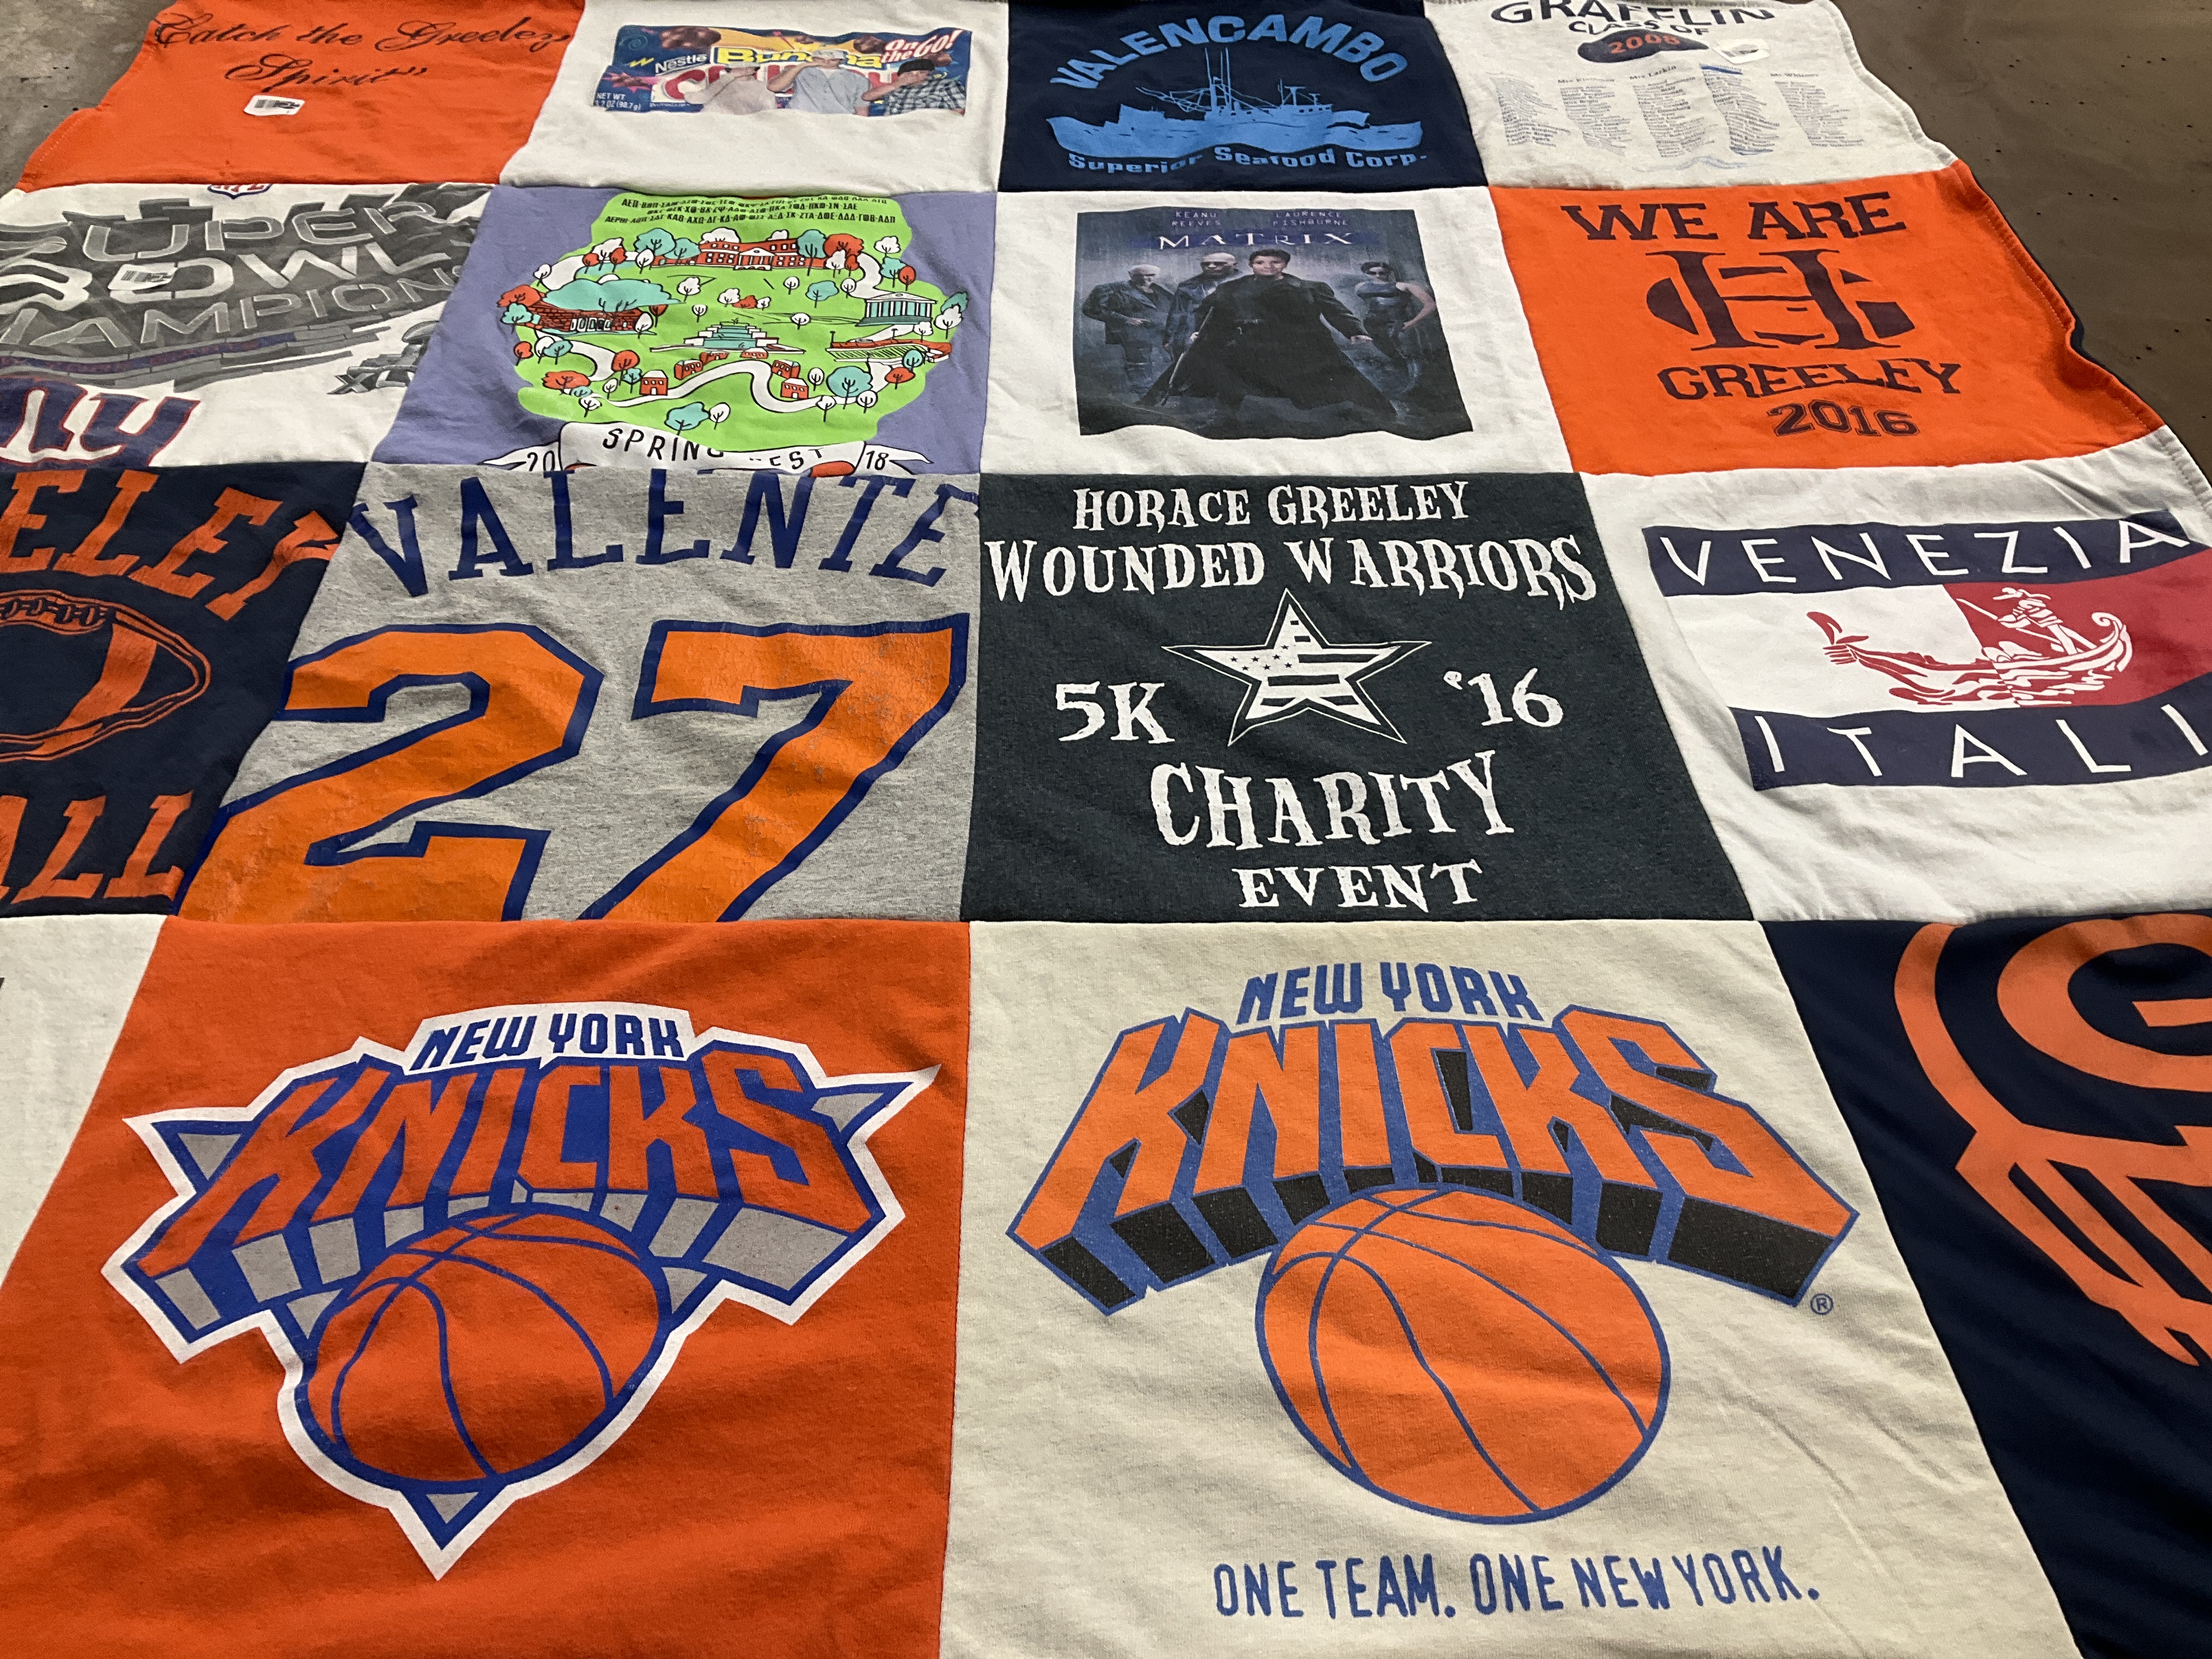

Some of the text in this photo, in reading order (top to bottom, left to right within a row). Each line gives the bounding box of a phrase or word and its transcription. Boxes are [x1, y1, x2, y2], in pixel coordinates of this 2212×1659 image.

[153, 13, 571, 53] Catch the Greeley
[885, 38, 921, 50] On
[915, 30, 966, 59] GO!
[1049, 14, 1408, 89] VALENCAMBO
[1568, 20, 1709, 36] CLASS OF
[1607, 33, 1681, 54] 2008
[881, 50, 913, 63] the
[1068, 152, 1203, 174] Superior
[1214, 145, 1336, 166] Seafood
[1158, 232, 1354, 250] MATRIX
[1175, 210, 1343, 219] KEANU LAURENCE
[1561, 191, 1908, 241] WE ARE
[1656, 357, 1962, 400] GREELEY
[1767, 399, 1921, 438] 2016
[865, 450, 889, 471] 18
[349, 469, 979, 596] VALENTE
[1072, 481, 1469, 533] HORACE GREELEY
[984, 535, 1597, 610] WOUNDED WARRIORS
[1660, 520, 2191, 587] VENEZIA
[1056, 681, 1175, 744] 5K
[1442, 668, 1564, 728] '16
[180, 613, 969, 922] 27
[1754, 703, 2210, 778] ITALI
[1150, 749, 1514, 850] CHARITY
[1232, 858, 1482, 912] EVENT
[1235, 961, 1544, 1026] NEW YORK
[409, 1013, 685, 1070] NEW YORK
[1008, 1006, 1859, 1256] KNICKS
[127, 1042, 886, 1286] KNICKS
[1214, 1545, 1821, 1620] ONE TEAM. ONE NEW YORK.
